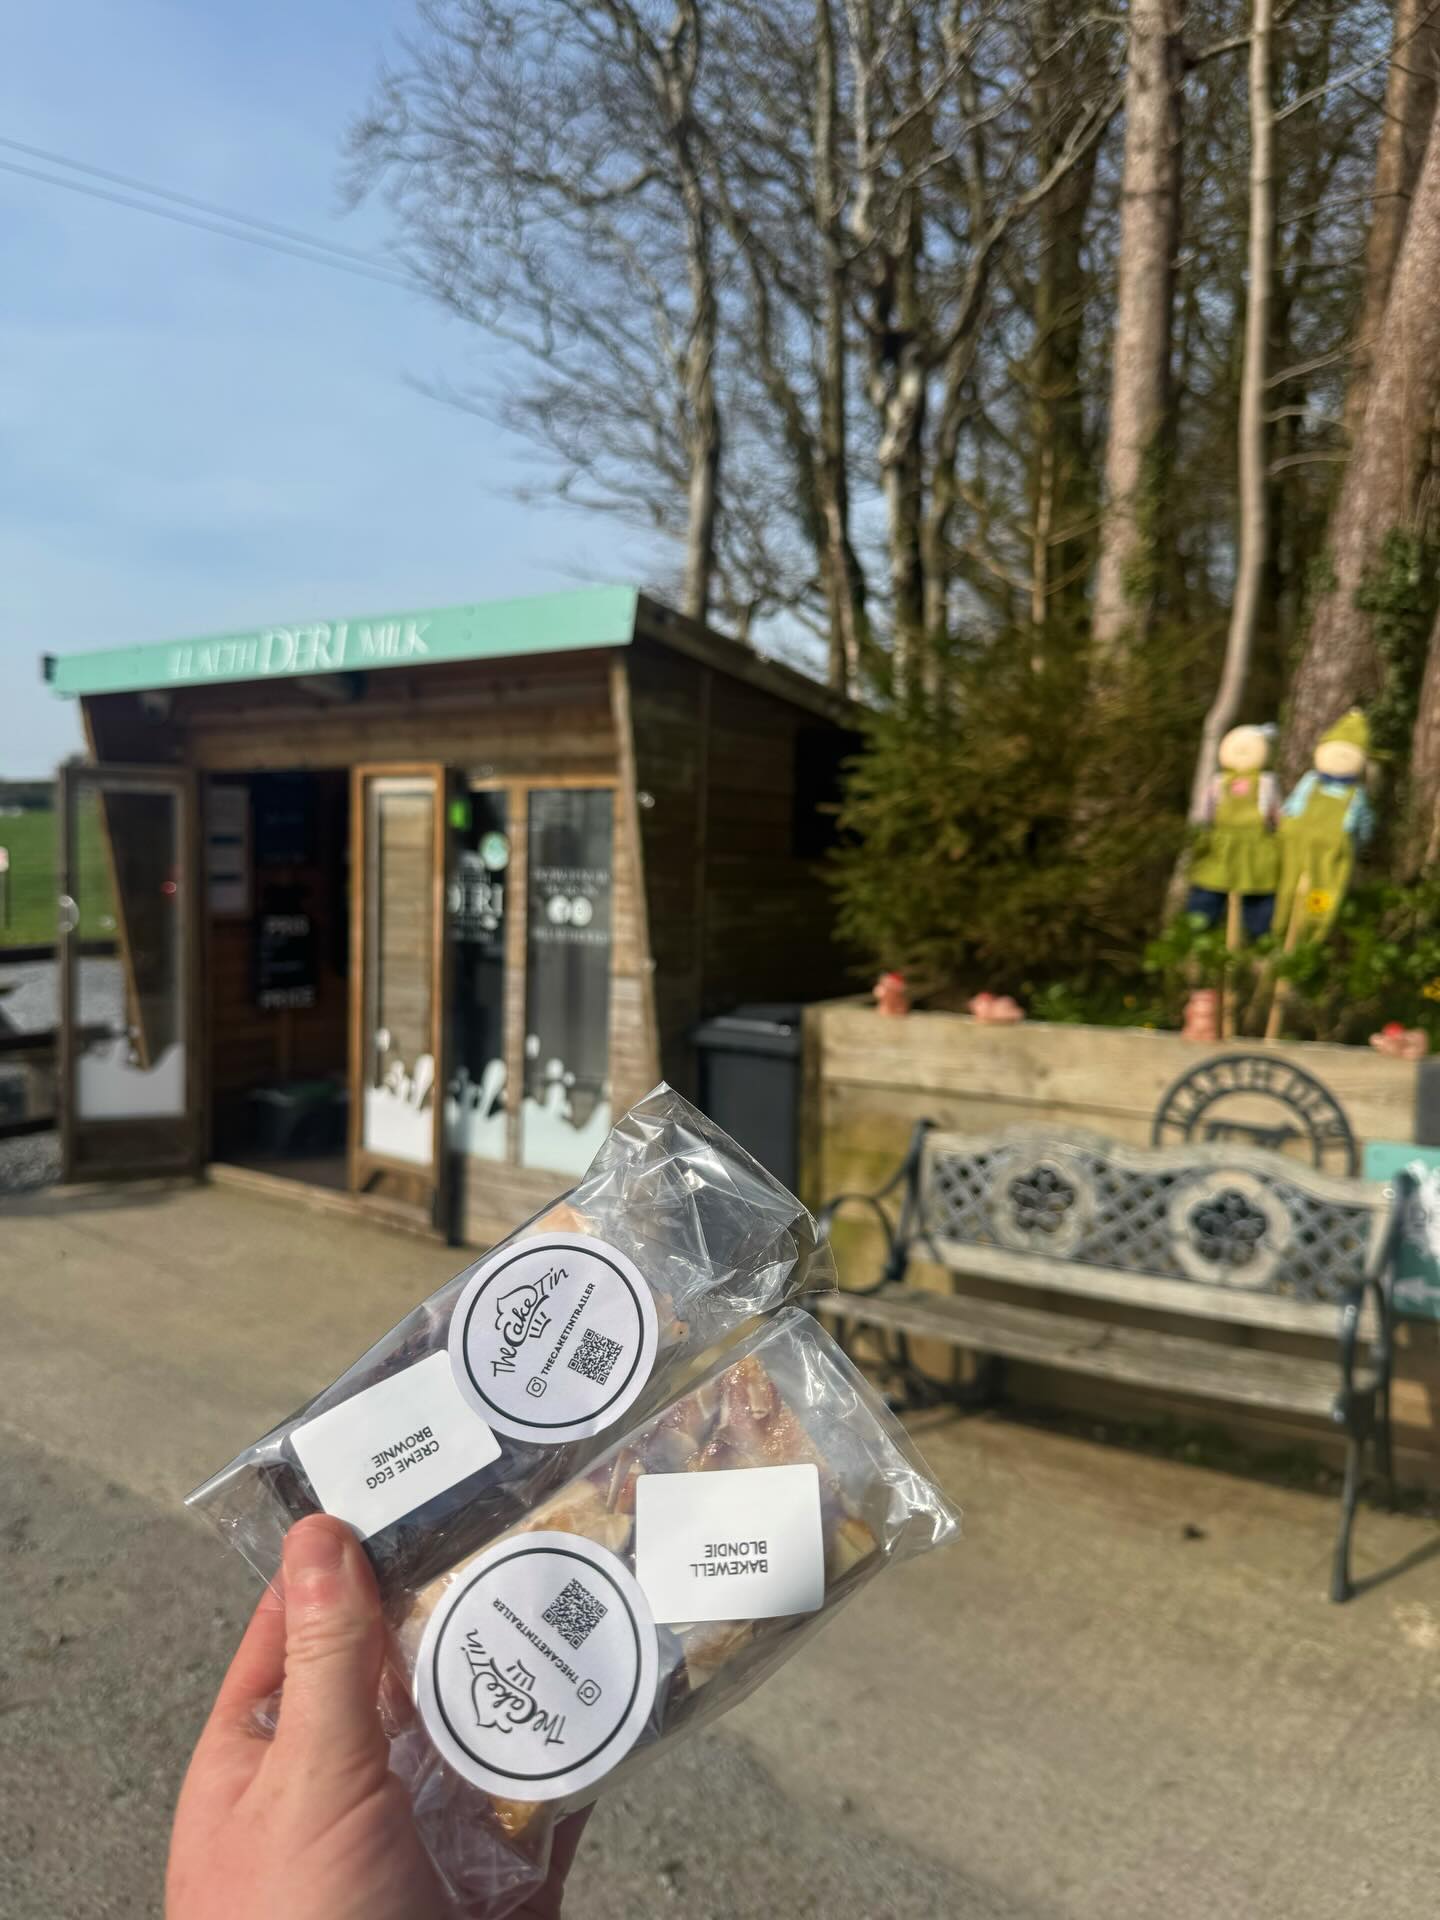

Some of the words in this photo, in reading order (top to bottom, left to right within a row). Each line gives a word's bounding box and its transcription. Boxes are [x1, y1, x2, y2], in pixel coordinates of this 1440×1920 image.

[258, 621, 348, 674] DERI
[358, 618, 431, 657] MILK
[491, 1344, 517, 1377] The
[504, 1296, 537, 1350] Cake
[533, 1268, 568, 1296] Tin
[543, 1283, 596, 1375] THECAKETINTRAILER
[372, 1426, 433, 1468] BROWNIE
[395, 1441, 440, 1472] CREME
[366, 1467, 394, 1489] EGG
[690, 1559, 769, 1577] BAKEWELL
[704, 1541, 768, 1559] BLONDIE
[461, 1630, 495, 1676] Tin
[493, 1598, 578, 1684] THECAKETINTRAILER
